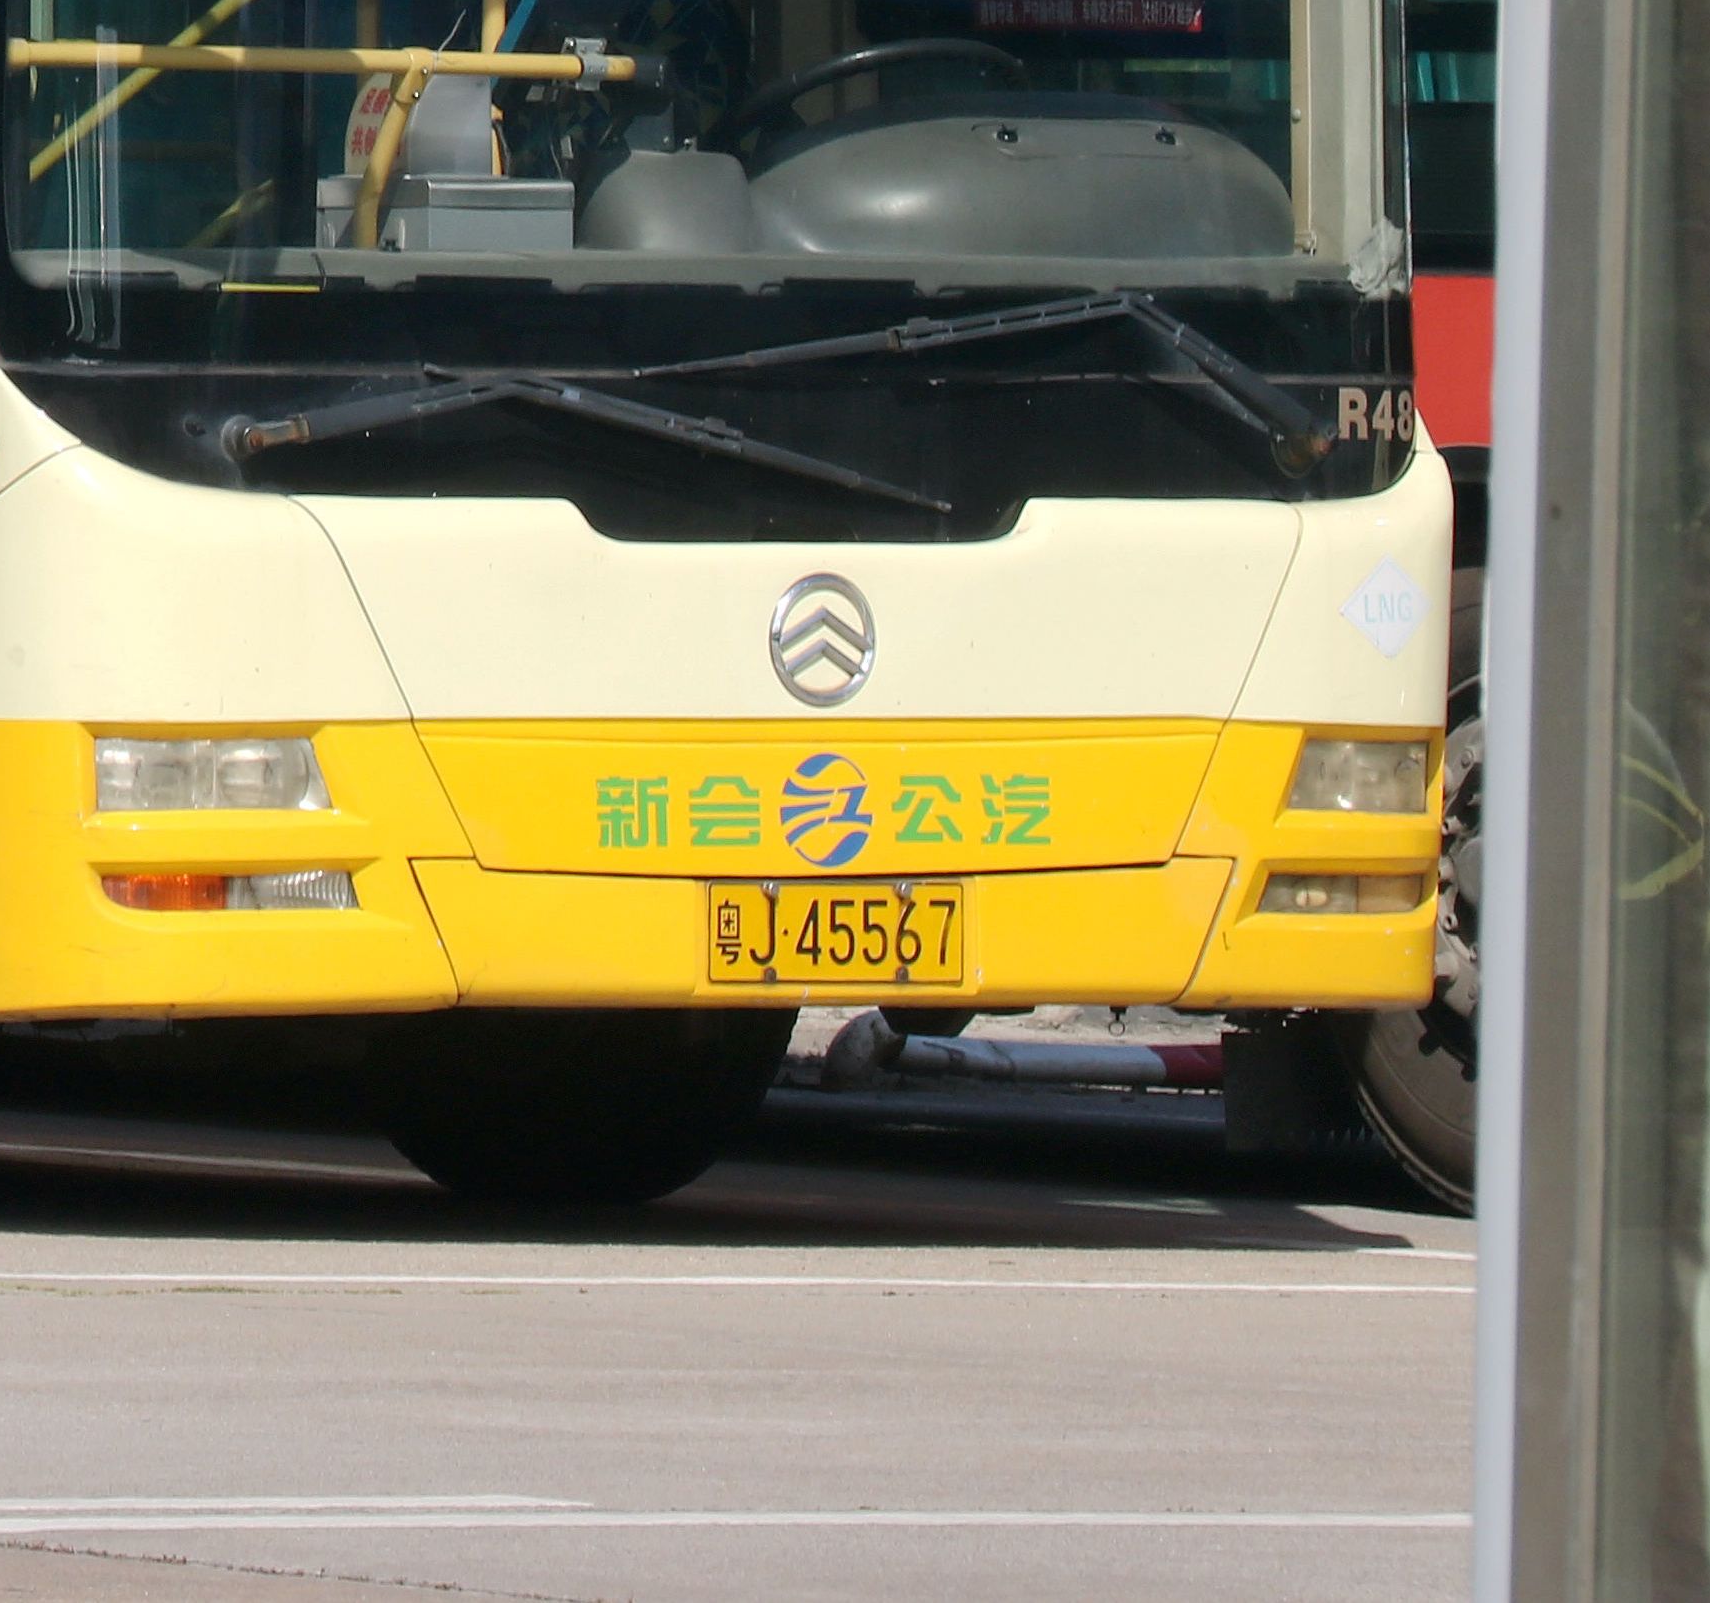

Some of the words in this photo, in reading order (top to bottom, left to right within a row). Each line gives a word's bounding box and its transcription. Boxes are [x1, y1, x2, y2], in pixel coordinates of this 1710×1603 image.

[1338, 386, 1414, 442] R48
[1363, 592, 1413, 624] LNG
[595, 775, 761, 849] 新会
[892, 773, 1052, 846] 公汽
